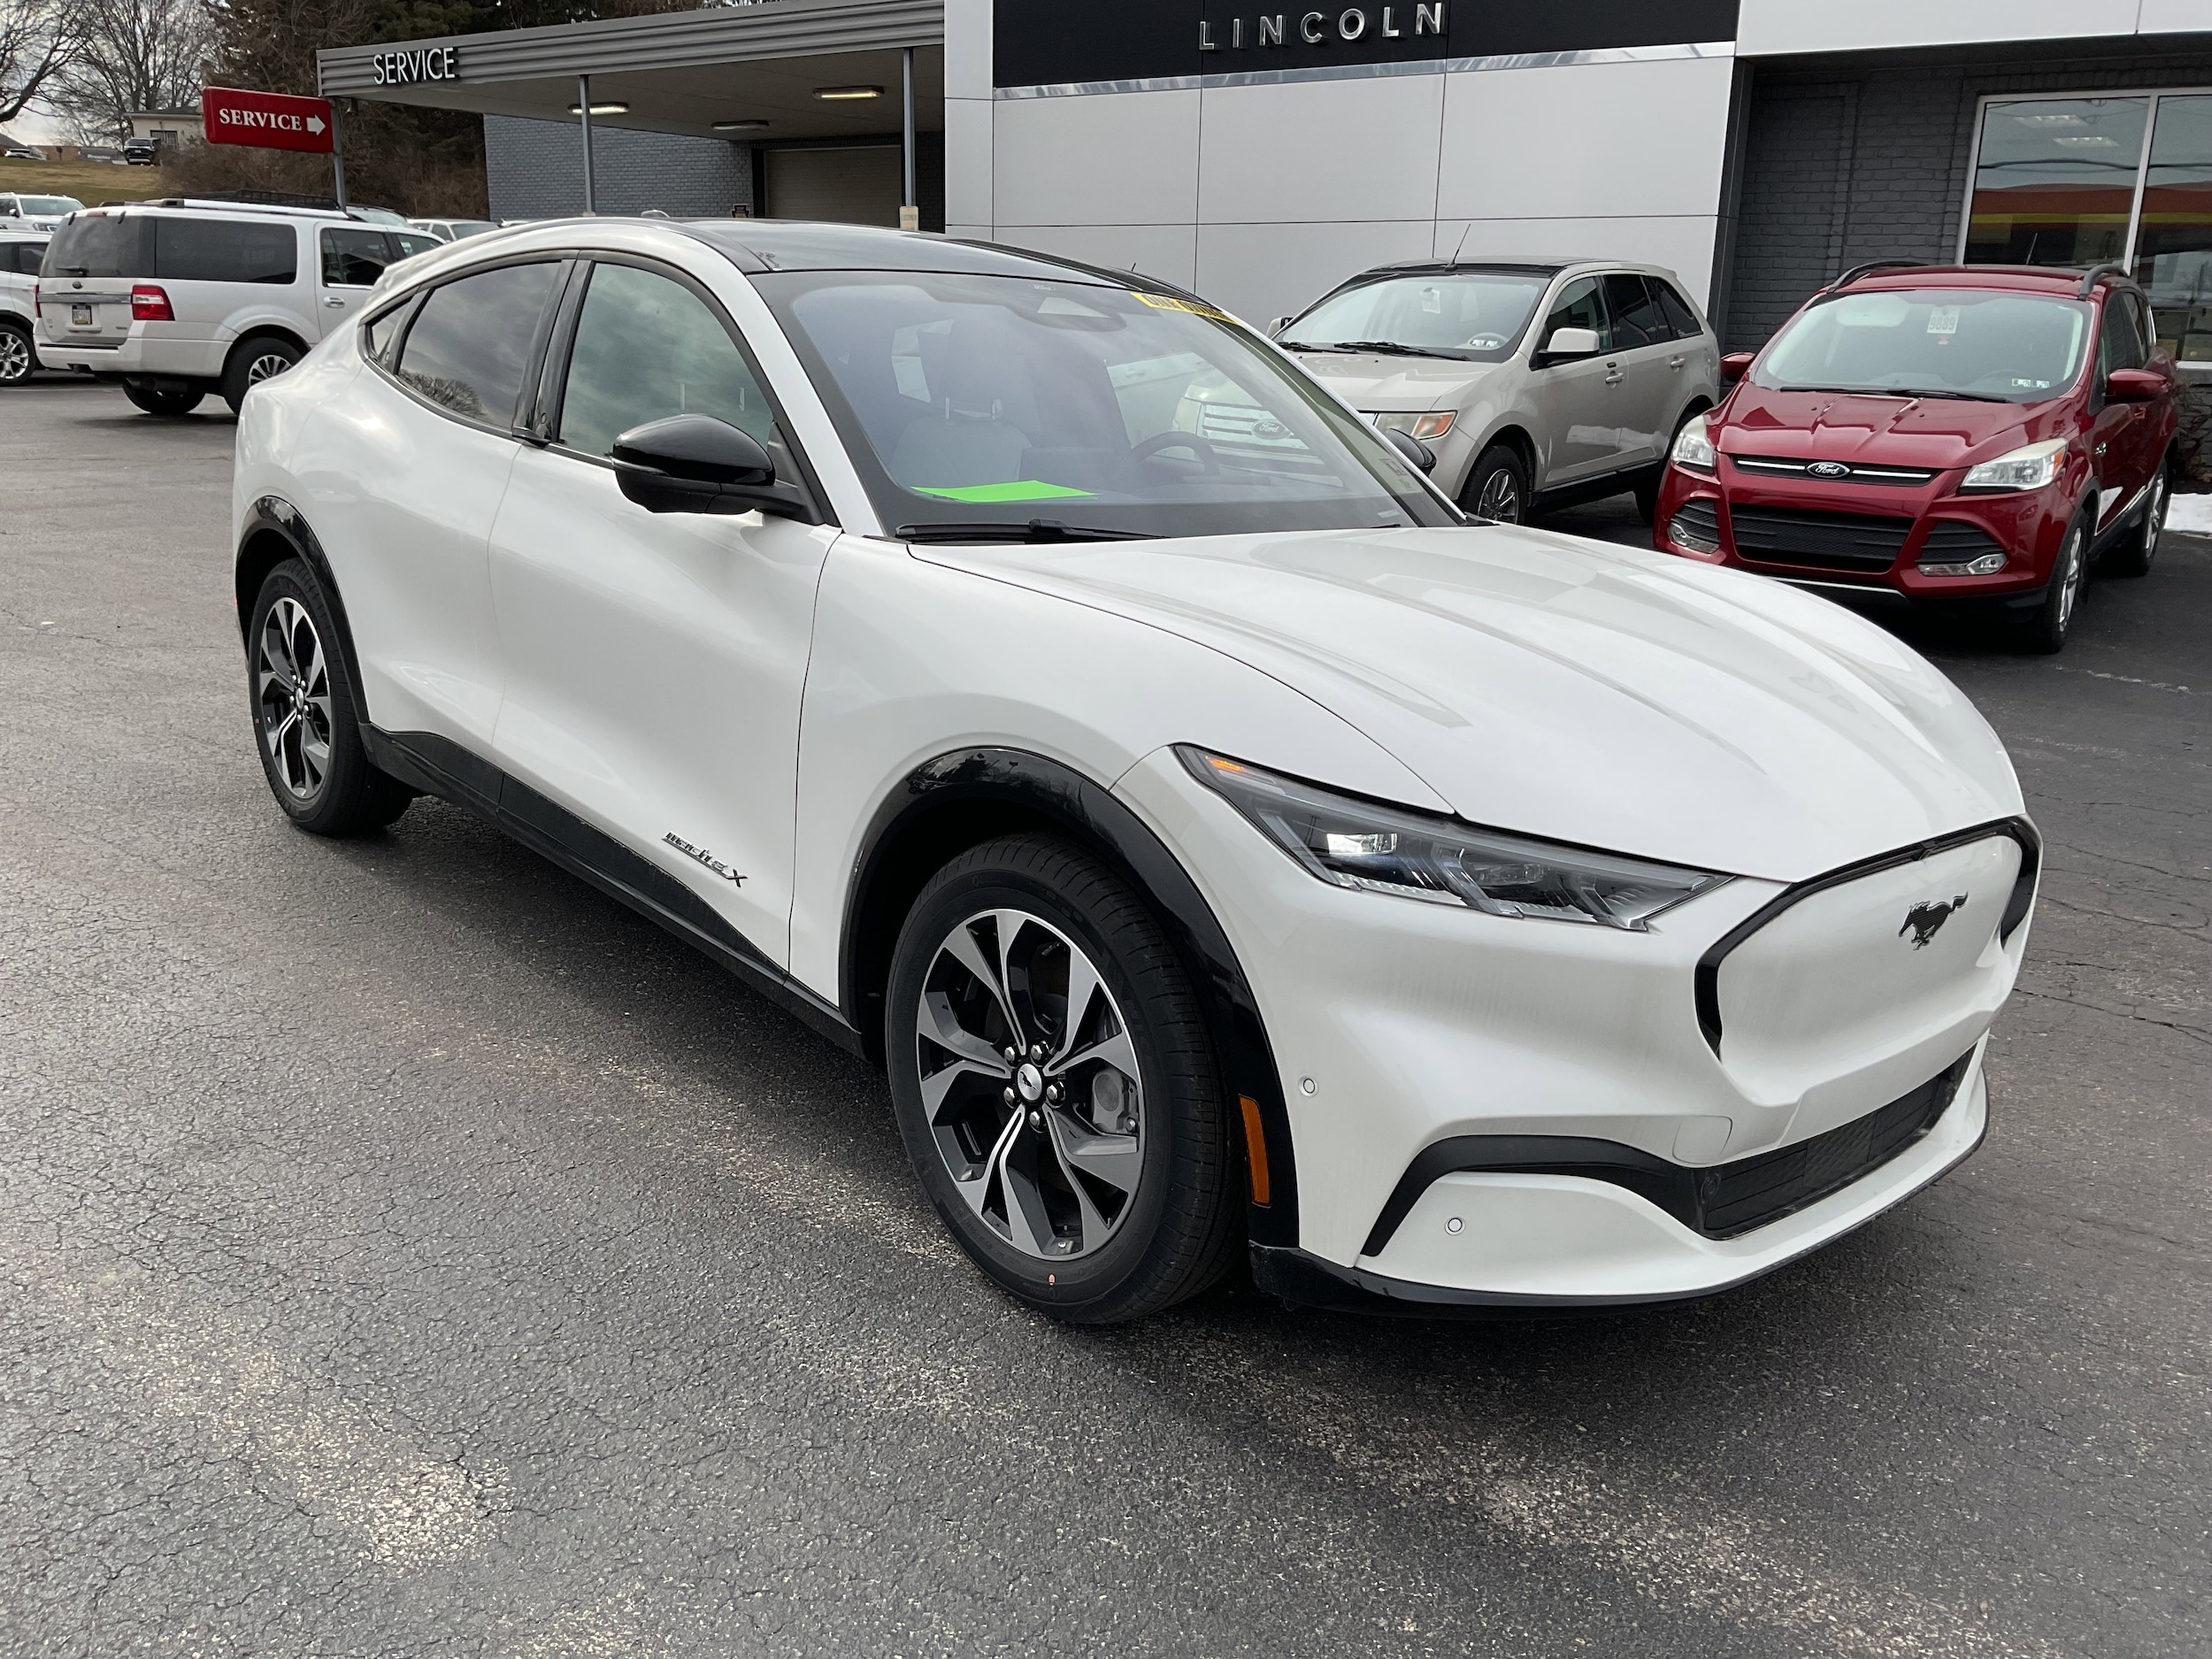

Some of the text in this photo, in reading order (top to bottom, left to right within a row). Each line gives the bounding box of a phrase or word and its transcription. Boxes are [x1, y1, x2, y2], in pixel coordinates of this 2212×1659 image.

[1199, 3, 1442, 50] LINCOLN
[373, 47, 456, 84] SERVICE
[219, 108, 302, 130] SERVICE
[1259, 423, 1280, 433] Ford
[1815, 464, 1840, 474] Ford
